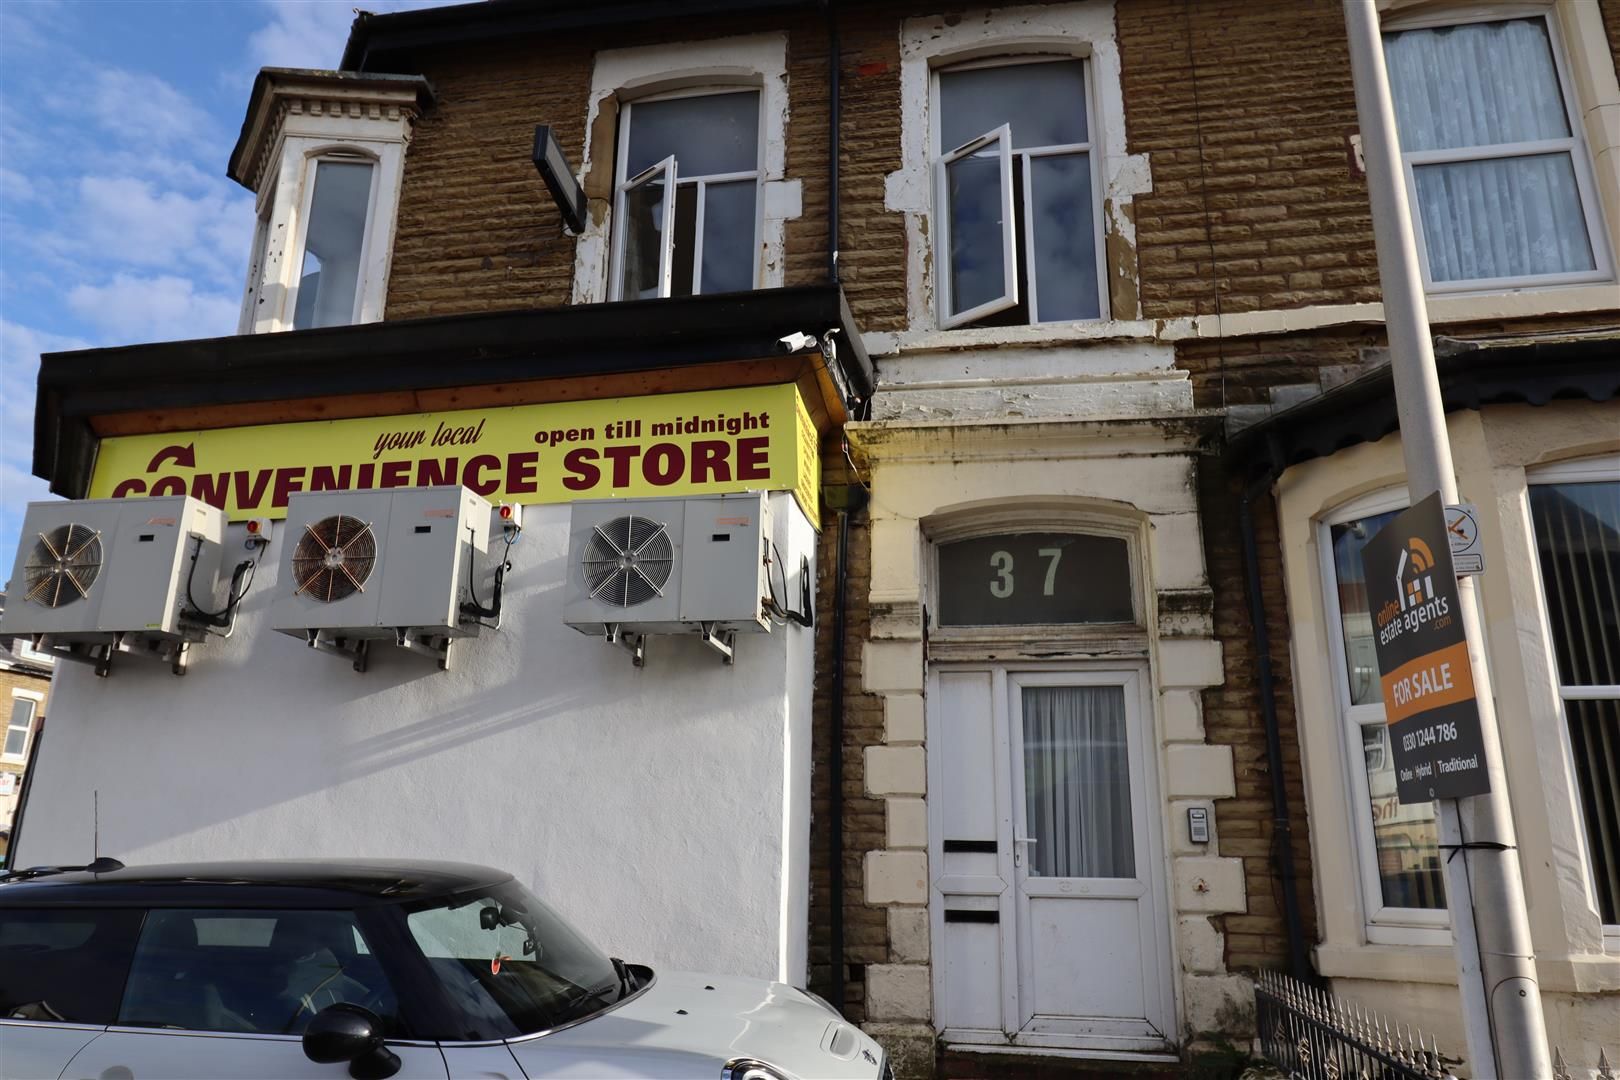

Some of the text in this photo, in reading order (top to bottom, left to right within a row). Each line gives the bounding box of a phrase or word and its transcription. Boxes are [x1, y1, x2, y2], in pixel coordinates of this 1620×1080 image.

[373, 418, 486, 460] your local
[534, 411, 770, 447] open till midnight
[562, 436, 771, 491] STORE
[1377, 599, 1400, 627] online
[1380, 596, 1449, 646] estate agents
[1433, 616, 1452, 631] .com
[1392, 662, 1454, 708] FOR SALE
[1402, 721, 1458, 752] 0330 1244 786
[1437, 754, 1479, 774] Traditional
